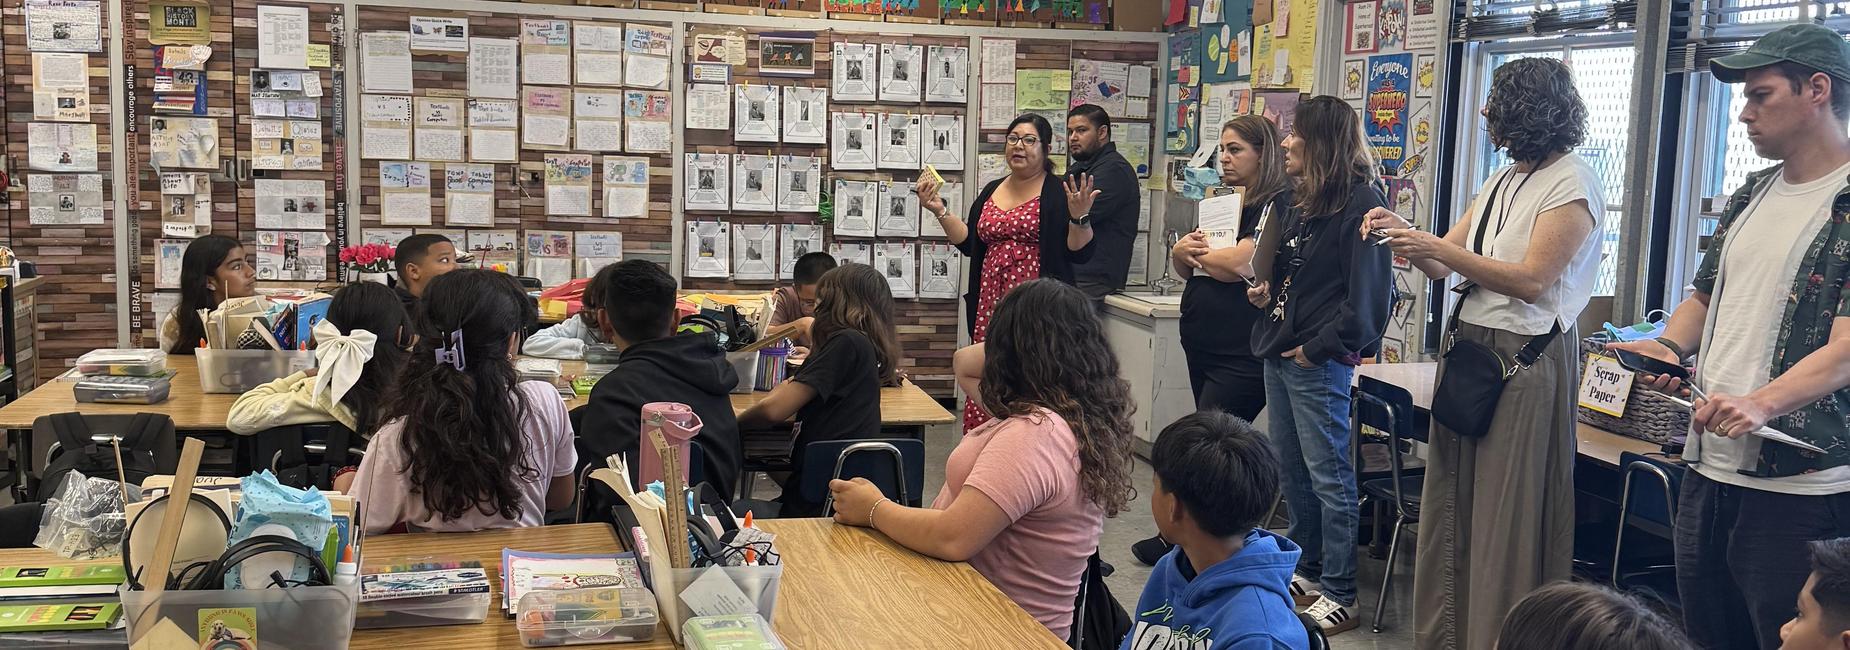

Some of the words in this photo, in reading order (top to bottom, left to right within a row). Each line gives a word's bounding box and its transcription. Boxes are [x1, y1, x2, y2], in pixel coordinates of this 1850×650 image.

[124, 0, 134, 38] inspired
[166, 6, 194, 14] BLACK
[124, 40, 134, 60] Stay
[332, 35, 343, 61] friend
[1370, 60, 1408, 81] Everyone
[334, 80, 342, 97] STAY
[1368, 91, 1407, 112] SUPERHERO
[334, 98, 342, 130] POSITIVE
[1386, 134, 1392, 143] to
[1392, 133, 1400, 142] be
[128, 134, 137, 174] important
[128, 176, 136, 189] are
[336, 174, 344, 190] fun
[132, 280, 140, 312] BRAVE
[132, 315, 141, 328] BE
[1594, 366, 1620, 384] Scrap
[1590, 386, 1616, 403] Paper
